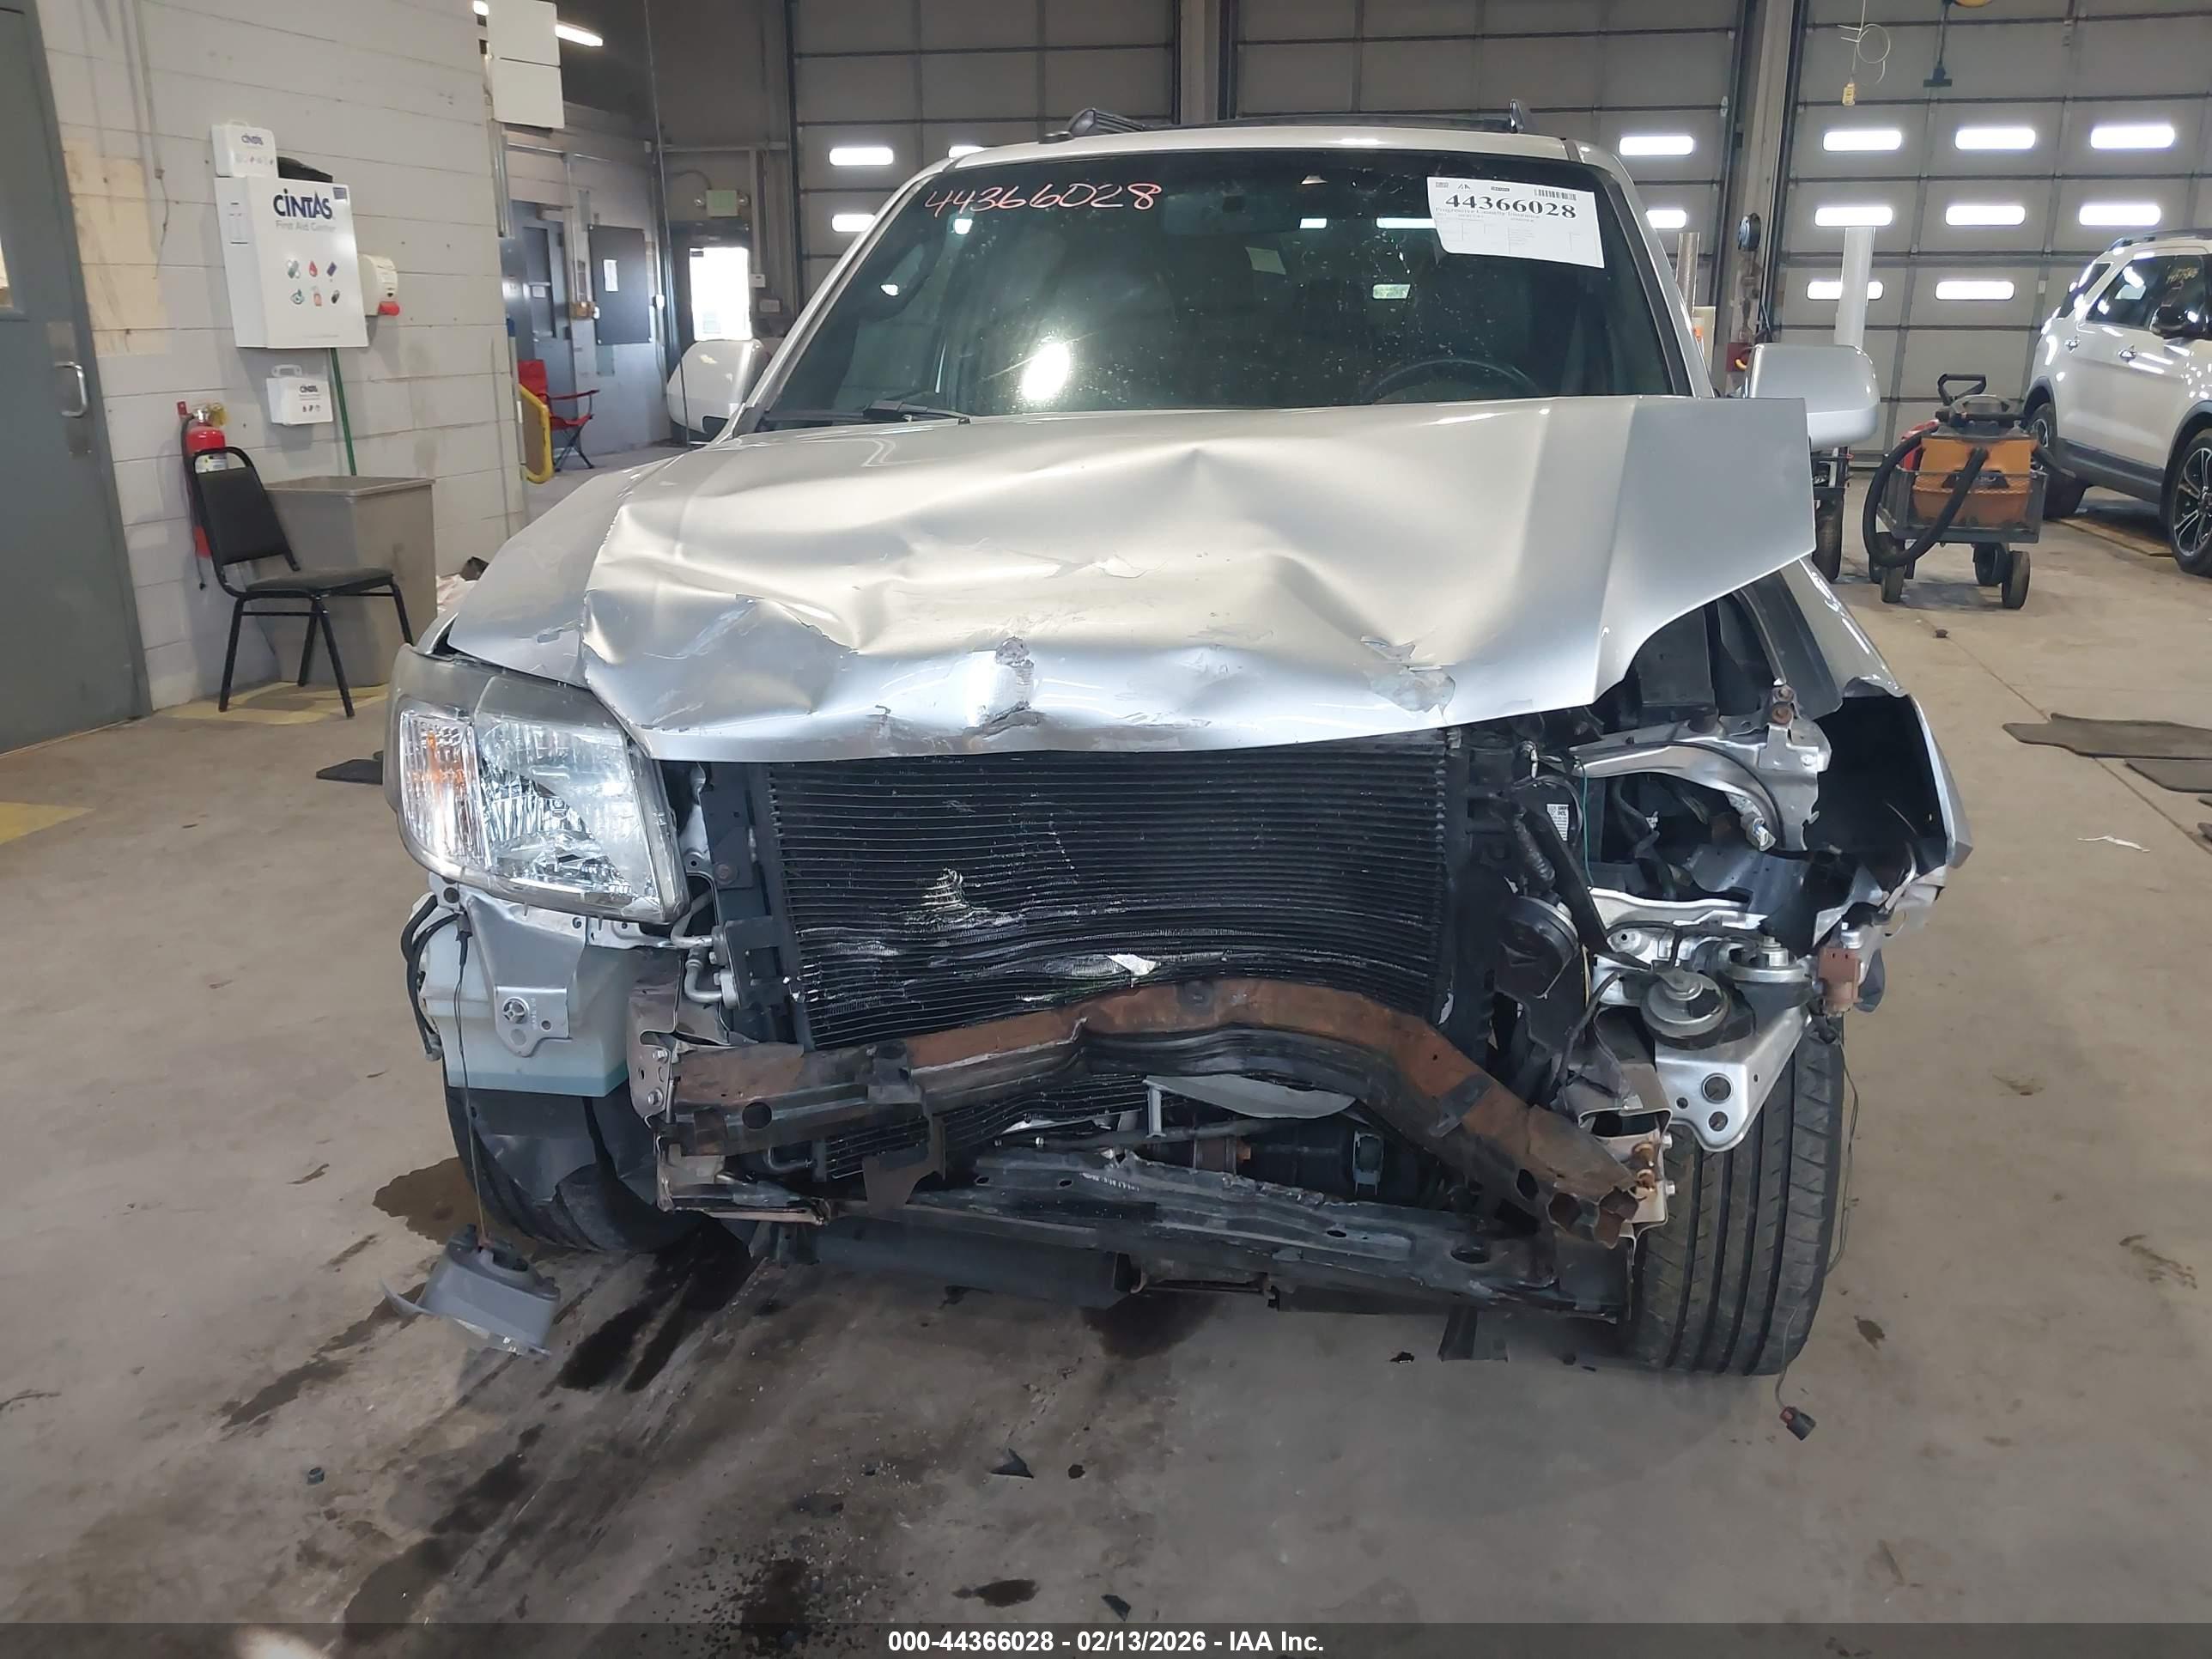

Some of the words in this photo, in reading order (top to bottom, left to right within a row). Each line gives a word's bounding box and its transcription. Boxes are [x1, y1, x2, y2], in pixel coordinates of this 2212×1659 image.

[273, 188, 333, 220] CINTAS
[924, 183, 1162, 218] 44366028
[1445, 194, 1577, 219] 44366028
